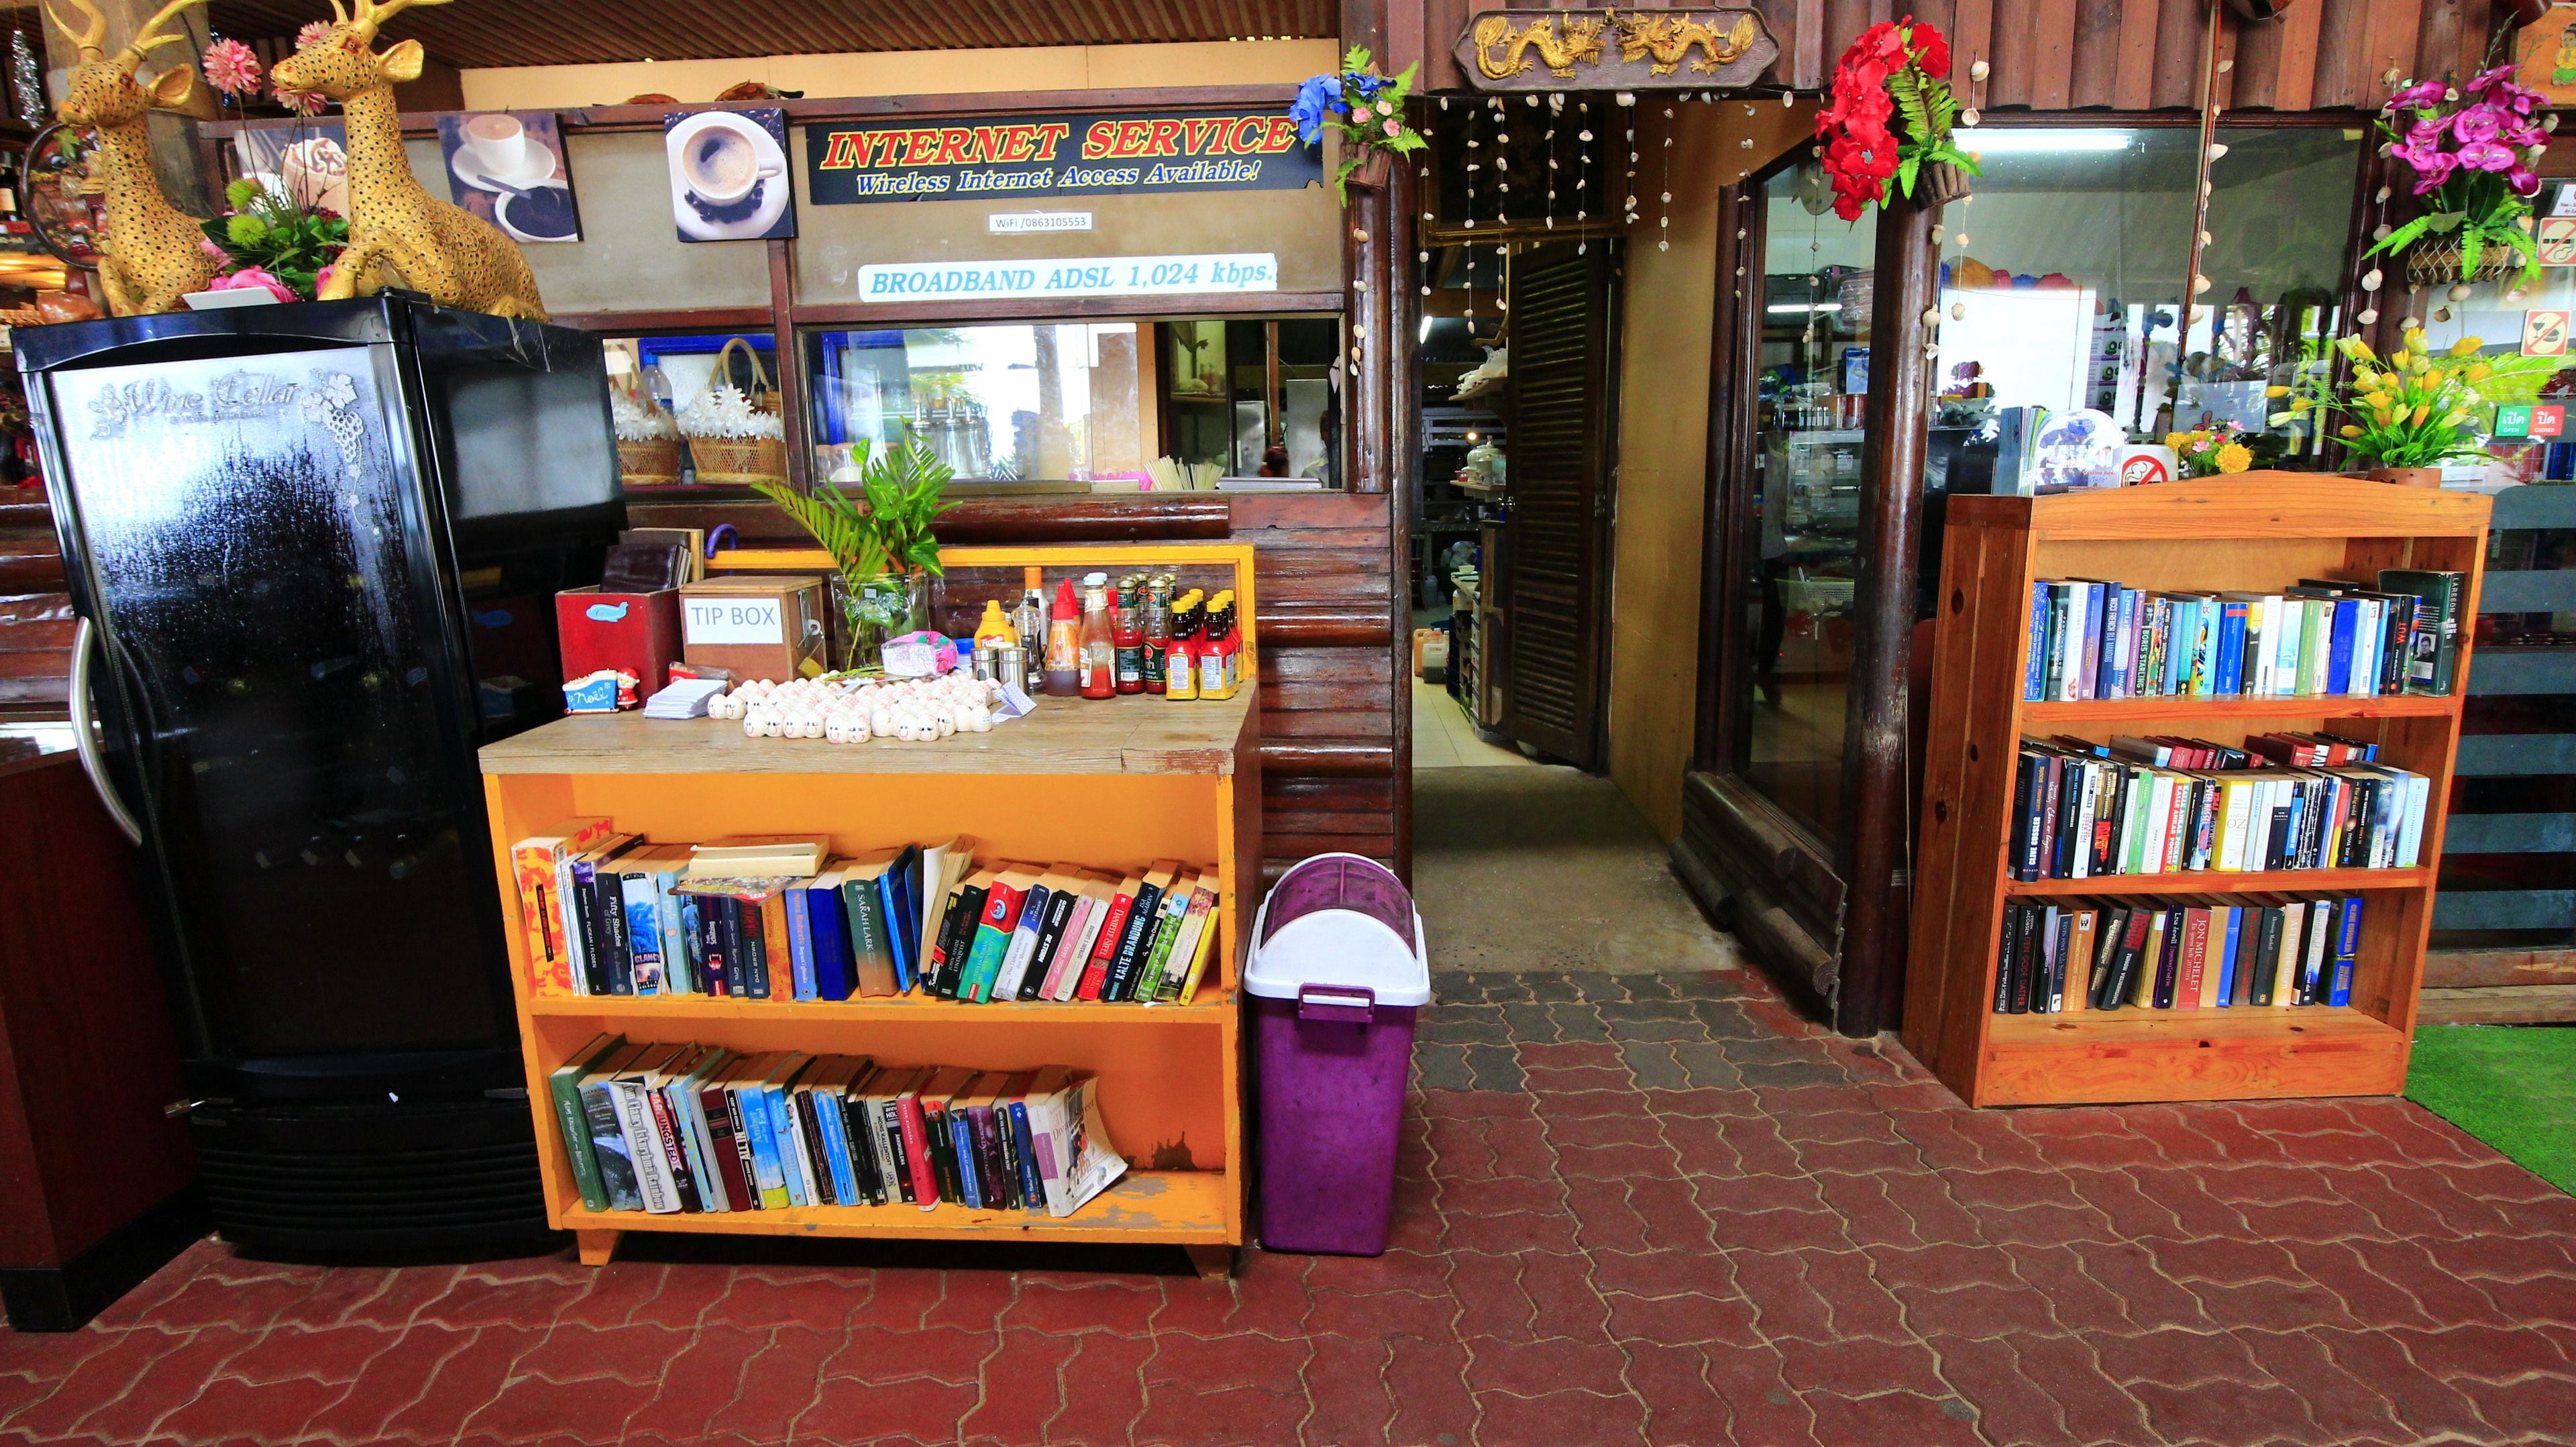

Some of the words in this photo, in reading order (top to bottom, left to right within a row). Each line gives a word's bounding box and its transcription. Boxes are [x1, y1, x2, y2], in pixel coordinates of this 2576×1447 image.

[820, 123, 1069, 170] INTERNET
[1082, 115, 1298, 160] SERVICE
[857, 172, 951, 195] Wireless
[957, 168, 1055, 192] Internet
[1057, 166, 1140, 187] Access
[1144, 160, 1262, 184] Available!
[995, 218, 1018, 227] WiFi
[1021, 217, 1086, 228] /0863105553
[871, 270, 1035, 294] BROADBAND
[1044, 266, 1114, 290] ADSL
[1126, 262, 1199, 289] 1,024
[1213, 262, 1273, 290] kbps.
[2502, 411, 2524, 424] เปิด
[2536, 411, 2555, 424] ปิด
[2109, 597, 2118, 612] NICCI
[2123, 595, 2132, 614] Lynda
[2449, 577, 2459, 612] LARSSON
[691, 607, 723, 625] TIP
[732, 606, 775, 625] BOX
[2106, 612, 2116, 631] FRENCH
[2124, 615, 2130, 623] La
[2106, 632, 2115, 641] BLÅ
[2140, 629, 2149, 652] BORIS
[2395, 621, 2408, 644] WUT
[2103, 641, 2114, 663] MANDAG
[2136, 653, 2147, 688] STARLING
[574, 686, 608, 704] Noël
[2174, 785, 2182, 808] KALLE
[2180, 784, 2189, 809] KALLE
[2204, 784, 2214, 803] SVEN
[2170, 809, 2179, 834] ANKAS
[2176, 810, 2185, 835] ANKAS
[2201, 803, 2212, 826] HASSEL
[2227, 818, 2246, 829] OZ
[2031, 816, 2040, 845] CUSSLER
[2028, 846, 2037, 865] CLIVE
[2165, 837, 2175, 864] POCKET
[2172, 836, 2181, 863] POCKET
[604, 909, 610, 917] of
[608, 896, 618, 916] Fifty
[792, 892, 802, 912] Nora
[857, 893, 869, 925] SARAH
[1031, 900, 1042, 921] STEDMAN
[1059, 900, 1067, 912] CLIVE
[1138, 898, 1146, 908] ISA
[1142, 893, 1153, 916] MARON
[2349, 904, 2357, 922] CLIVE
[604, 918, 612, 935] Grey
[765, 918, 774, 938] Marian
[794, 914, 806, 945] Roberts
[1053, 911, 1062, 926] CUSSLER
[1106, 908, 1124, 938] DANIELLE
[2173, 912, 2181, 925] Lisa
[2194, 918, 2206, 940] JON
[2269, 916, 2277, 933] Henning
[612, 918, 622, 947] Shades
[862, 926, 874, 951] LARK
[1044, 933, 1053, 943] DE
[1122, 914, 1146, 957] BRANDUNG
[1145, 932, 1155, 948] Agatha
[1150, 918, 1161, 933] Christie
[2169, 926, 2179, 945] Jewell
[2344, 922, 2355, 953] CUSSLER
[749, 941, 758, 966] BROWN
[951, 939, 960, 955] AJVIDE
[1006, 964, 1014, 975] Das
[1010, 953, 1018, 964] Licht
[1014, 931, 1025, 953] zwischen
[1036, 941, 1049, 962] STORM
[1098, 937, 1112, 957] STEEL
[2023, 936, 2031, 953] DEN
[952, 940, 965, 972] LINDQVIST
[2021, 955, 2029, 977] GODE
[2190, 941, 2203, 992] MICHELET
[1114, 955, 1131, 981] KALTE
[1149, 963, 1158, 976] Harold
[2017, 979, 2026, 1006] DATTER
[647, 1087, 665, 1115] MARI
[624, 1100, 647, 1130] Clancy
[735, 1130, 747, 1143] IN
[749, 1110, 761, 1143] Amber
[631, 1128, 657, 1175] Iskuryhmä
[655, 1112, 683, 1170] JUNGSTEDT
[737, 1142, 751, 1161] ALL
[879, 1132, 891, 1165] KALLENTOFT
[645, 1173, 667, 1210] Rainbow
